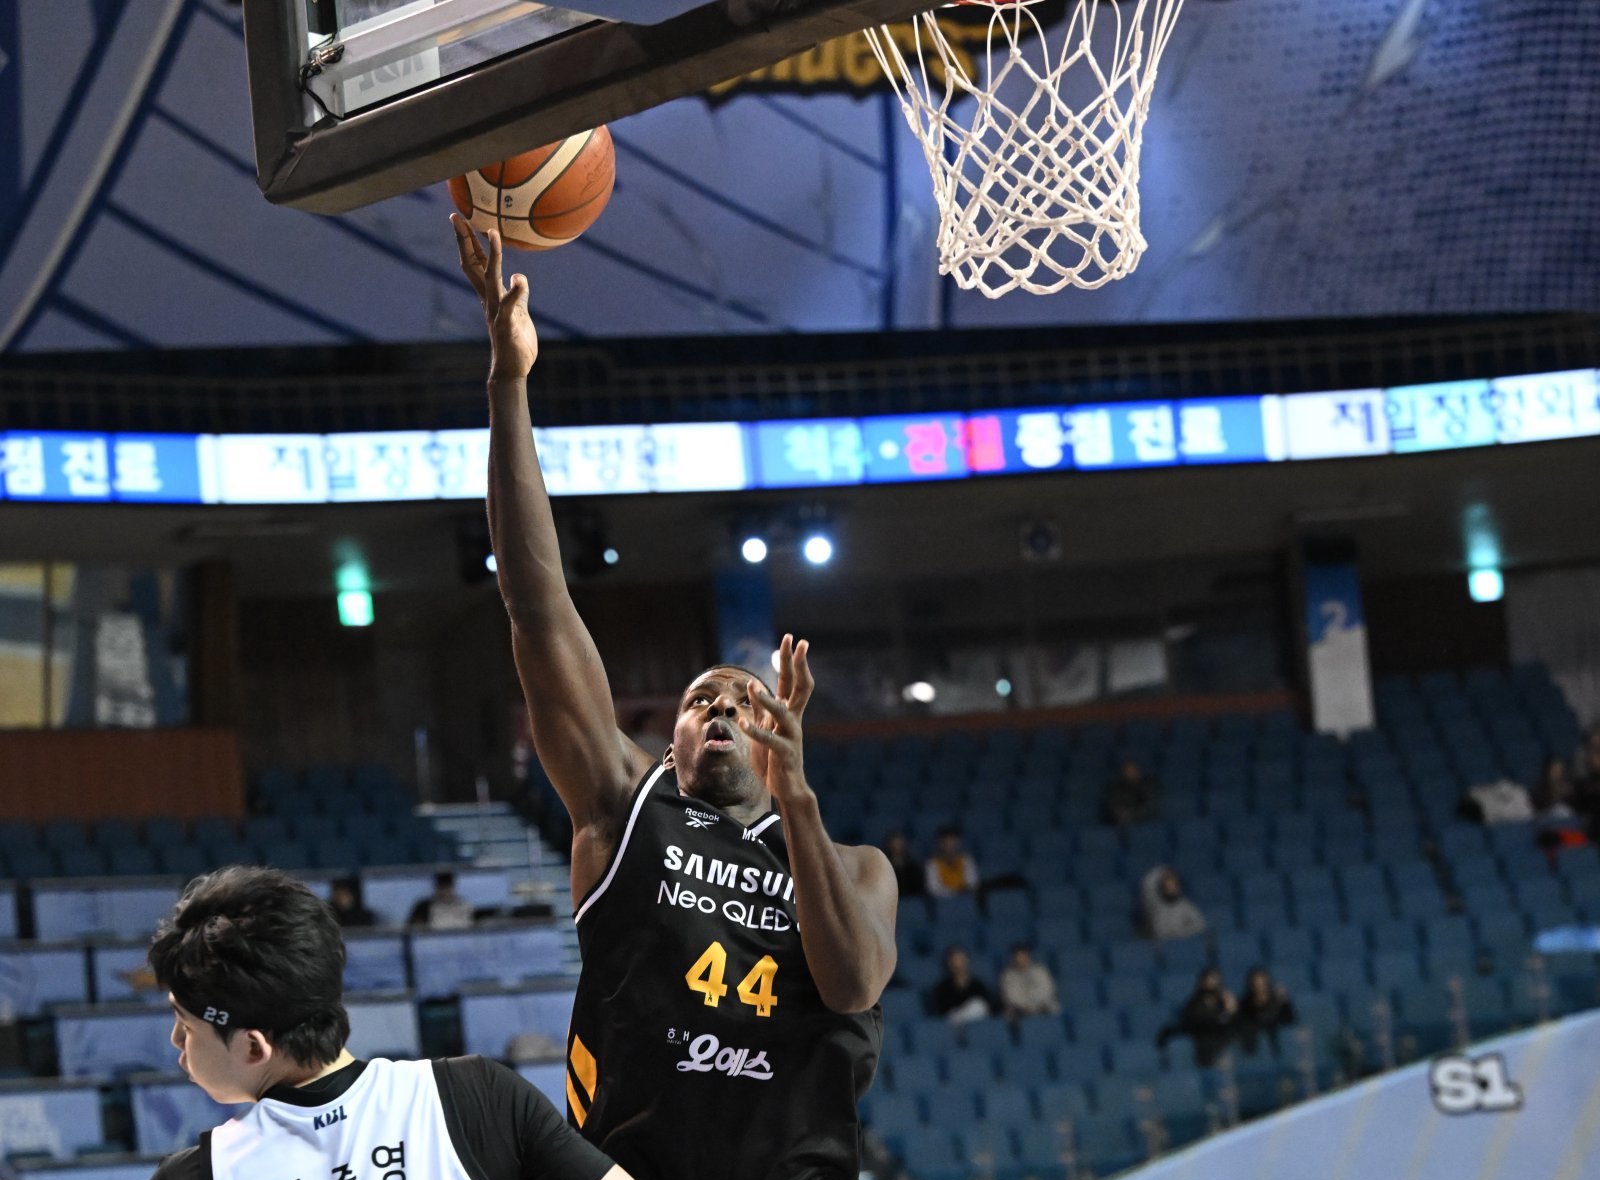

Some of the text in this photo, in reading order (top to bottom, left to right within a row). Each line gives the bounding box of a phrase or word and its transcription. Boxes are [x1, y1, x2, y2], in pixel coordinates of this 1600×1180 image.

[685, 807, 720, 822] Reebok
[664, 845, 796, 905] SAMSUN
[657, 880, 792, 932] Neo QLED
[685, 941, 778, 1018] 44
[203, 1006, 229, 1026] 23
[676, 1033, 774, 1080] 오예스
[1431, 1053, 1522, 1115] S1
[313, 1105, 347, 1131] KBL
